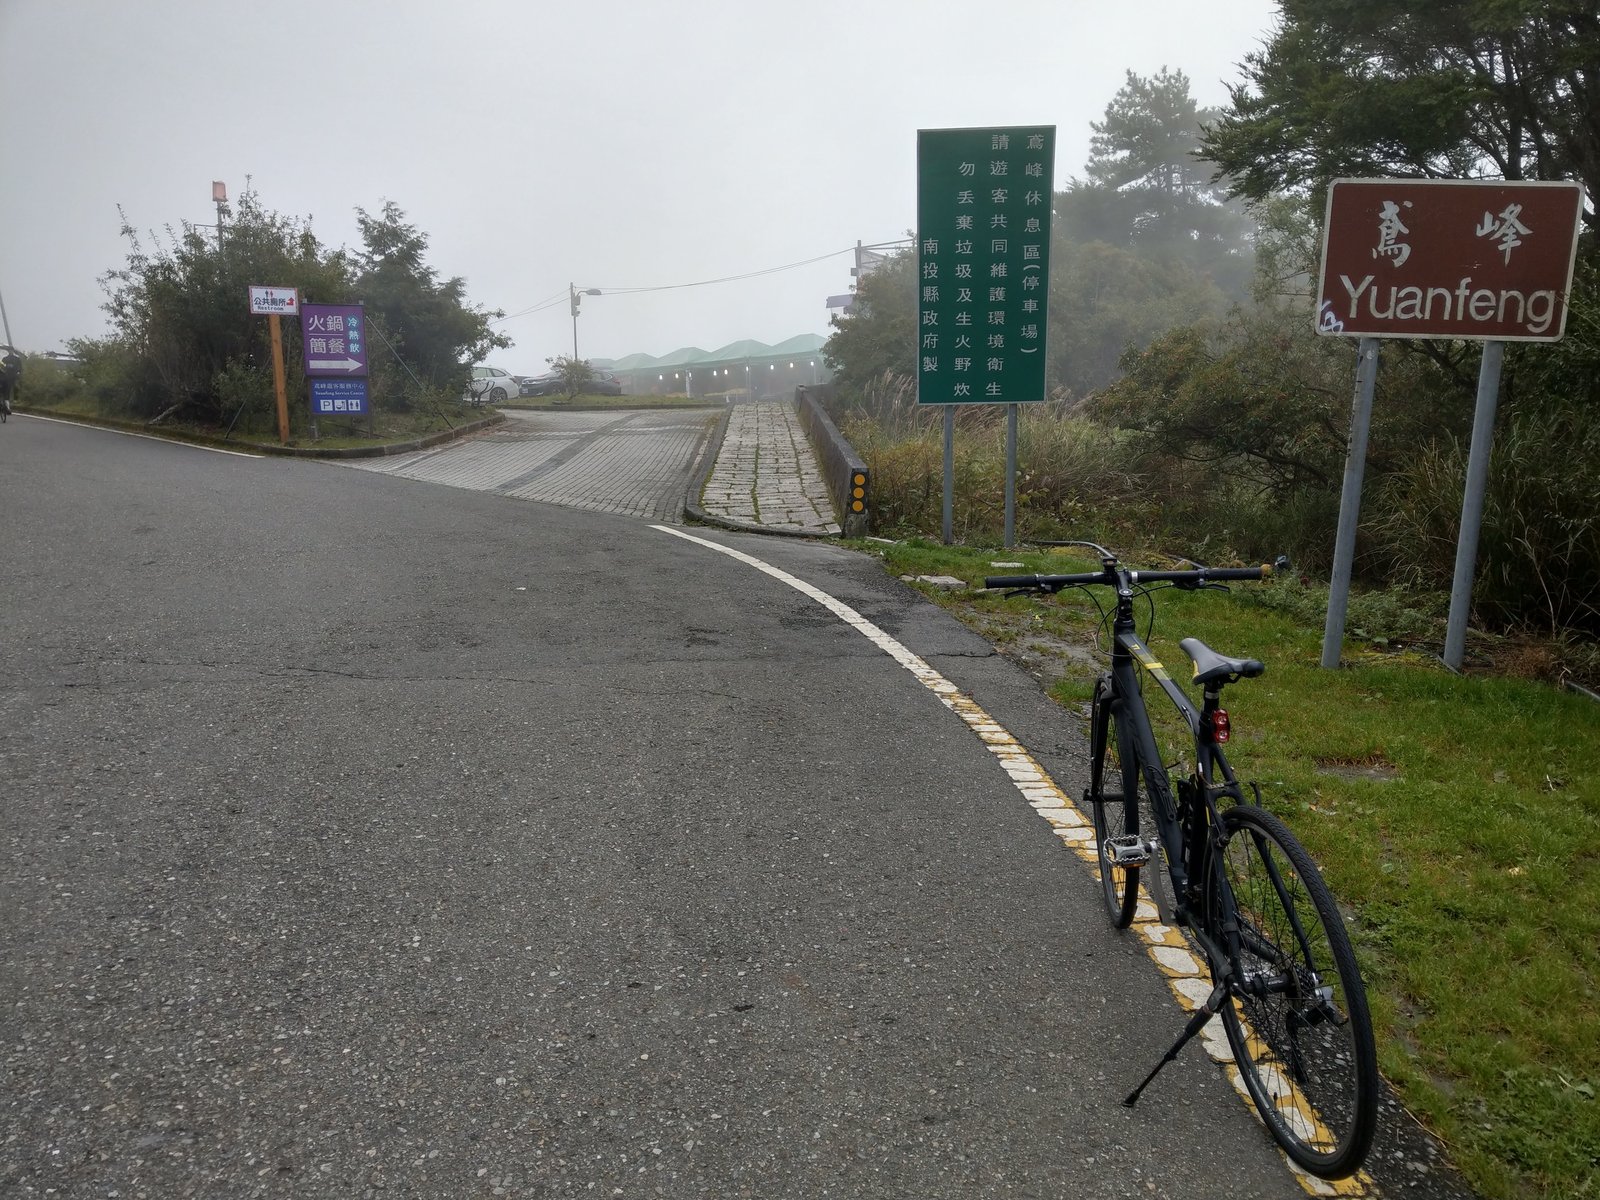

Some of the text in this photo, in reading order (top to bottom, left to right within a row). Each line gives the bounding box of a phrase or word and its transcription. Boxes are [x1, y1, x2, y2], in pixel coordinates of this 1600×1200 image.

[1371, 200, 1533, 267] 鳶峰
[986, 134, 1009, 396] 請遊客共同維護環境衛生
[254, 297, 286, 306] 公共廁所
[308, 314, 343, 331] 火鍋
[923, 238, 939, 372] 南投縣政府製
[1339, 275, 1556, 333] Yuanfeng
[309, 338, 345, 354] 簡餐
[347, 316, 360, 353] 冷熱飲
